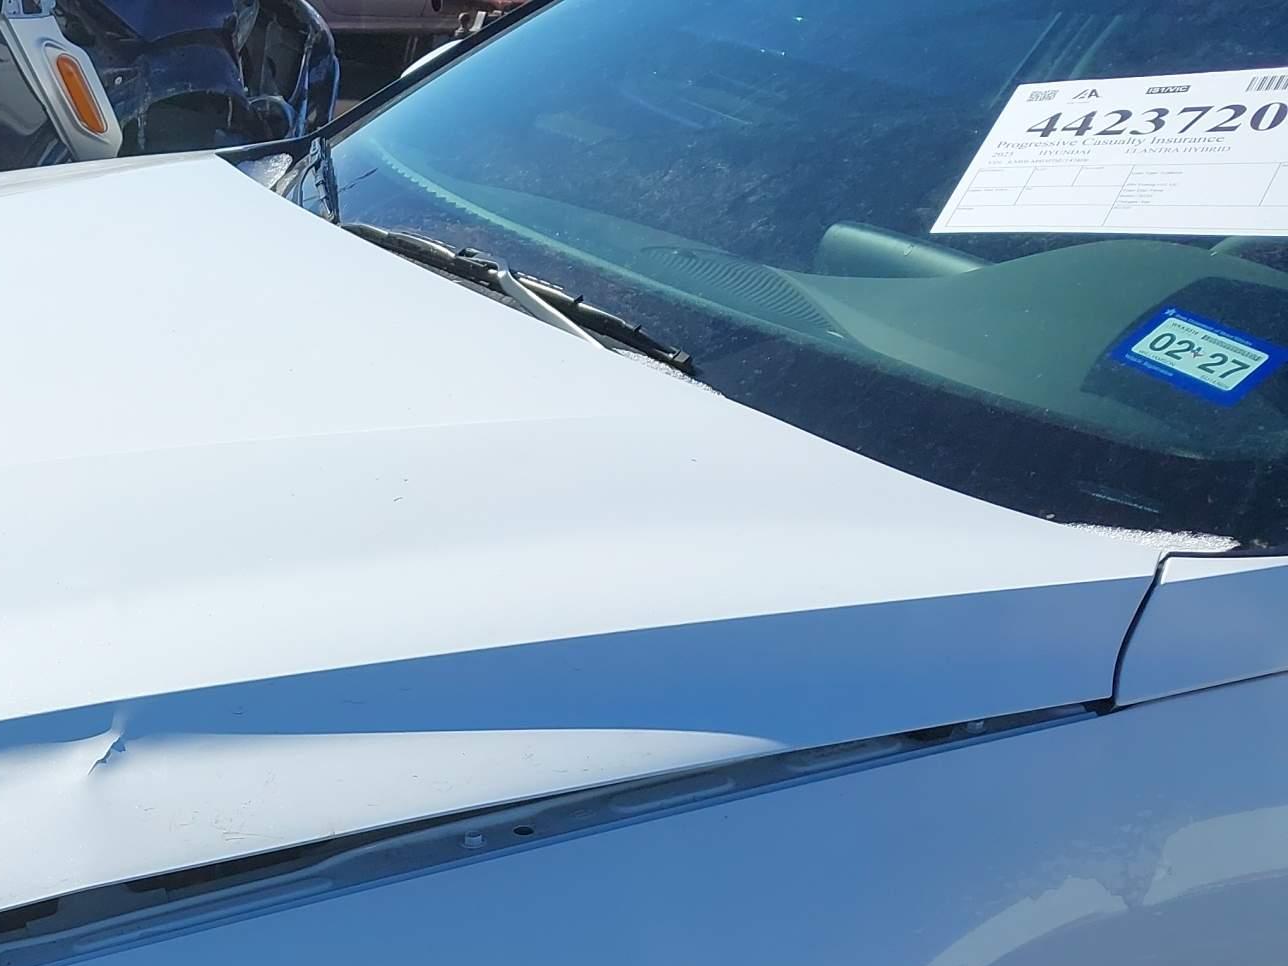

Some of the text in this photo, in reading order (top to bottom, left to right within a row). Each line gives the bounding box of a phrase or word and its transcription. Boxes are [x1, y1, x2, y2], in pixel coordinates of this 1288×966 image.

[996, 135, 1225, 150] Progressive Casualty Insurance
[1148, 333, 1195, 361] 02
[1198, 352, 1250, 379] 27
